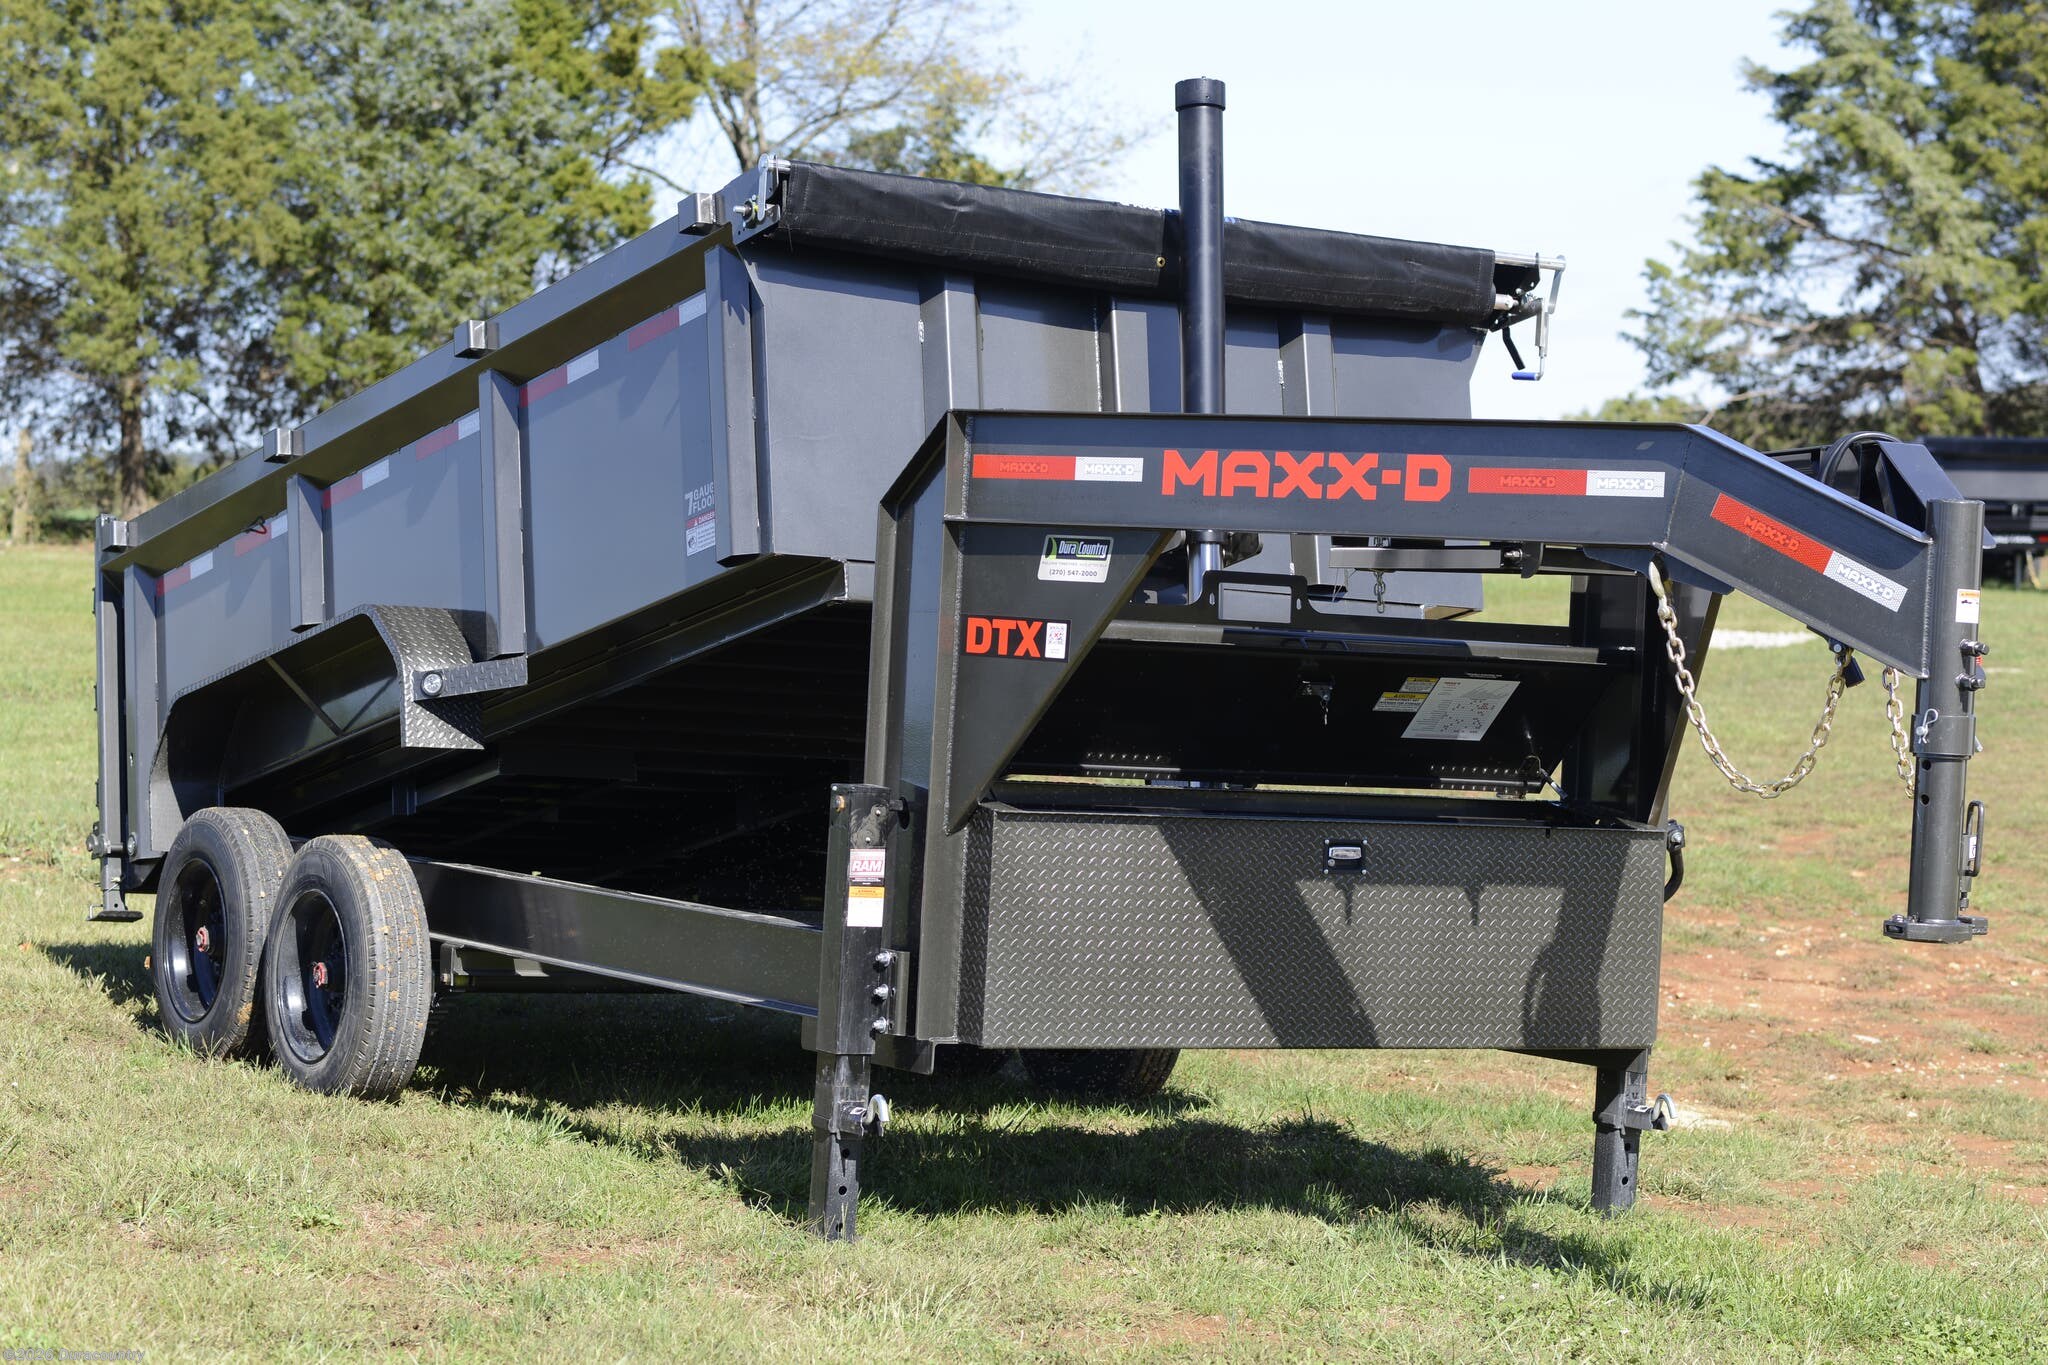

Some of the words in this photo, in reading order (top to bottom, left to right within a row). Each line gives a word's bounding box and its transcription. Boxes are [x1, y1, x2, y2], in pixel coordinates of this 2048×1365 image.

[1162, 450, 1452, 502] MAXX-D
[1058, 540, 1077, 554] Dura
[1077, 541, 1108, 556] Country
[966, 617, 1043, 658] DTX
[851, 860, 883, 872] RAM
